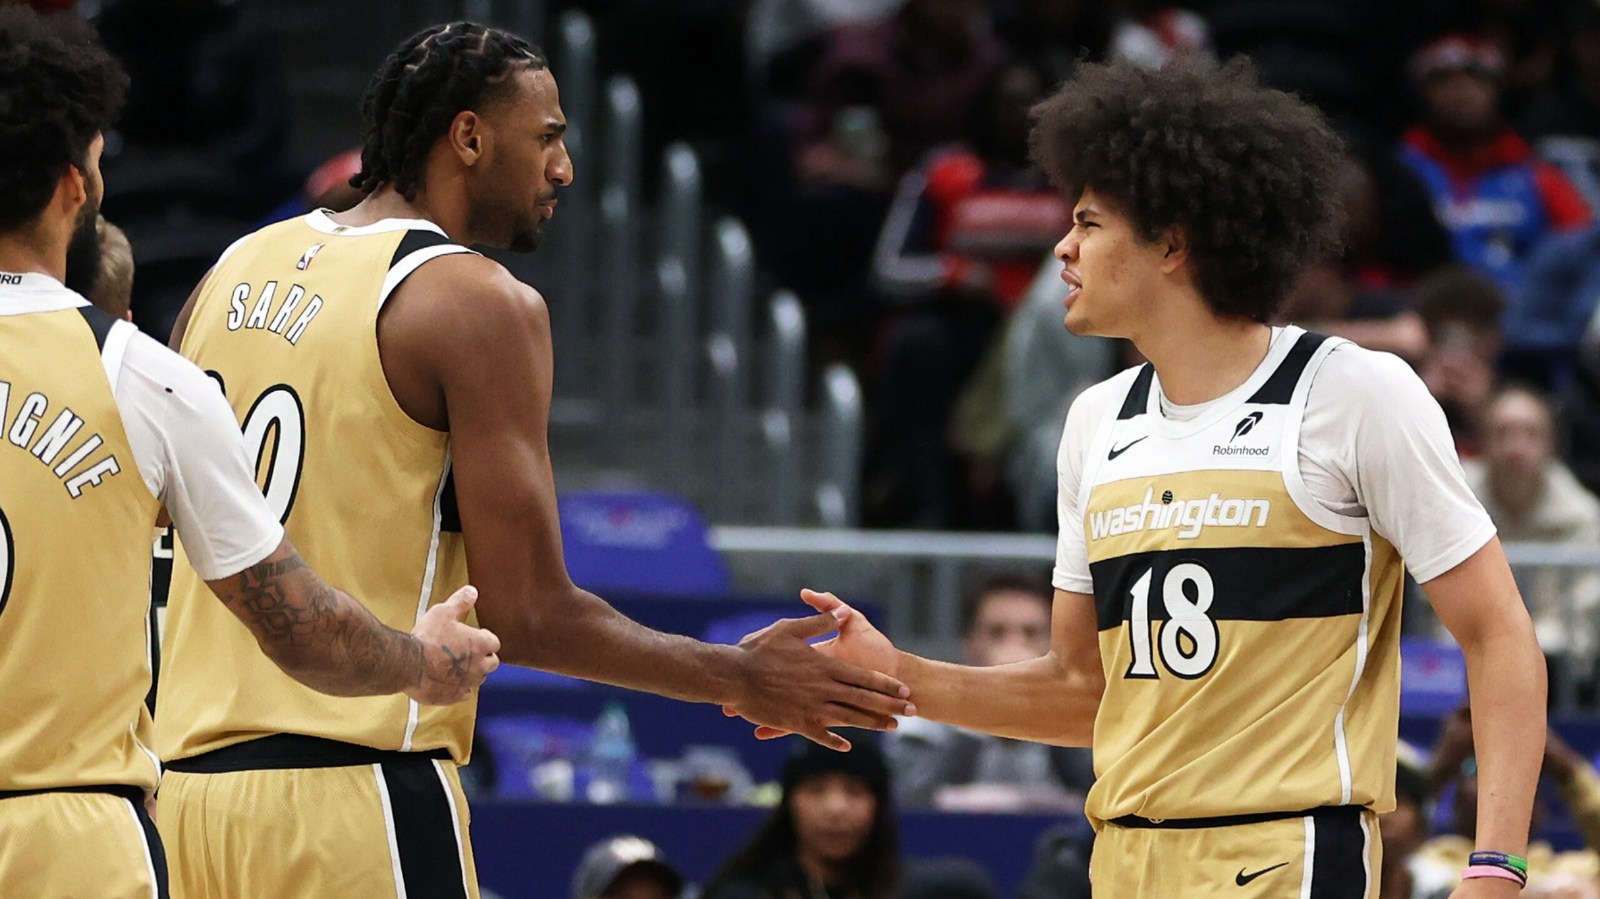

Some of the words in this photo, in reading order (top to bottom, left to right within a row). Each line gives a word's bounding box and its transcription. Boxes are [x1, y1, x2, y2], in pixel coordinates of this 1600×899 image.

[0, 273, 22, 285] RO
[227, 280, 324, 346] SARR
[204, 370, 306, 526] 0
[1212, 445, 1270, 456] Robinhood
[1089, 486, 1271, 541] washington
[1123, 559, 1220, 680] 18
